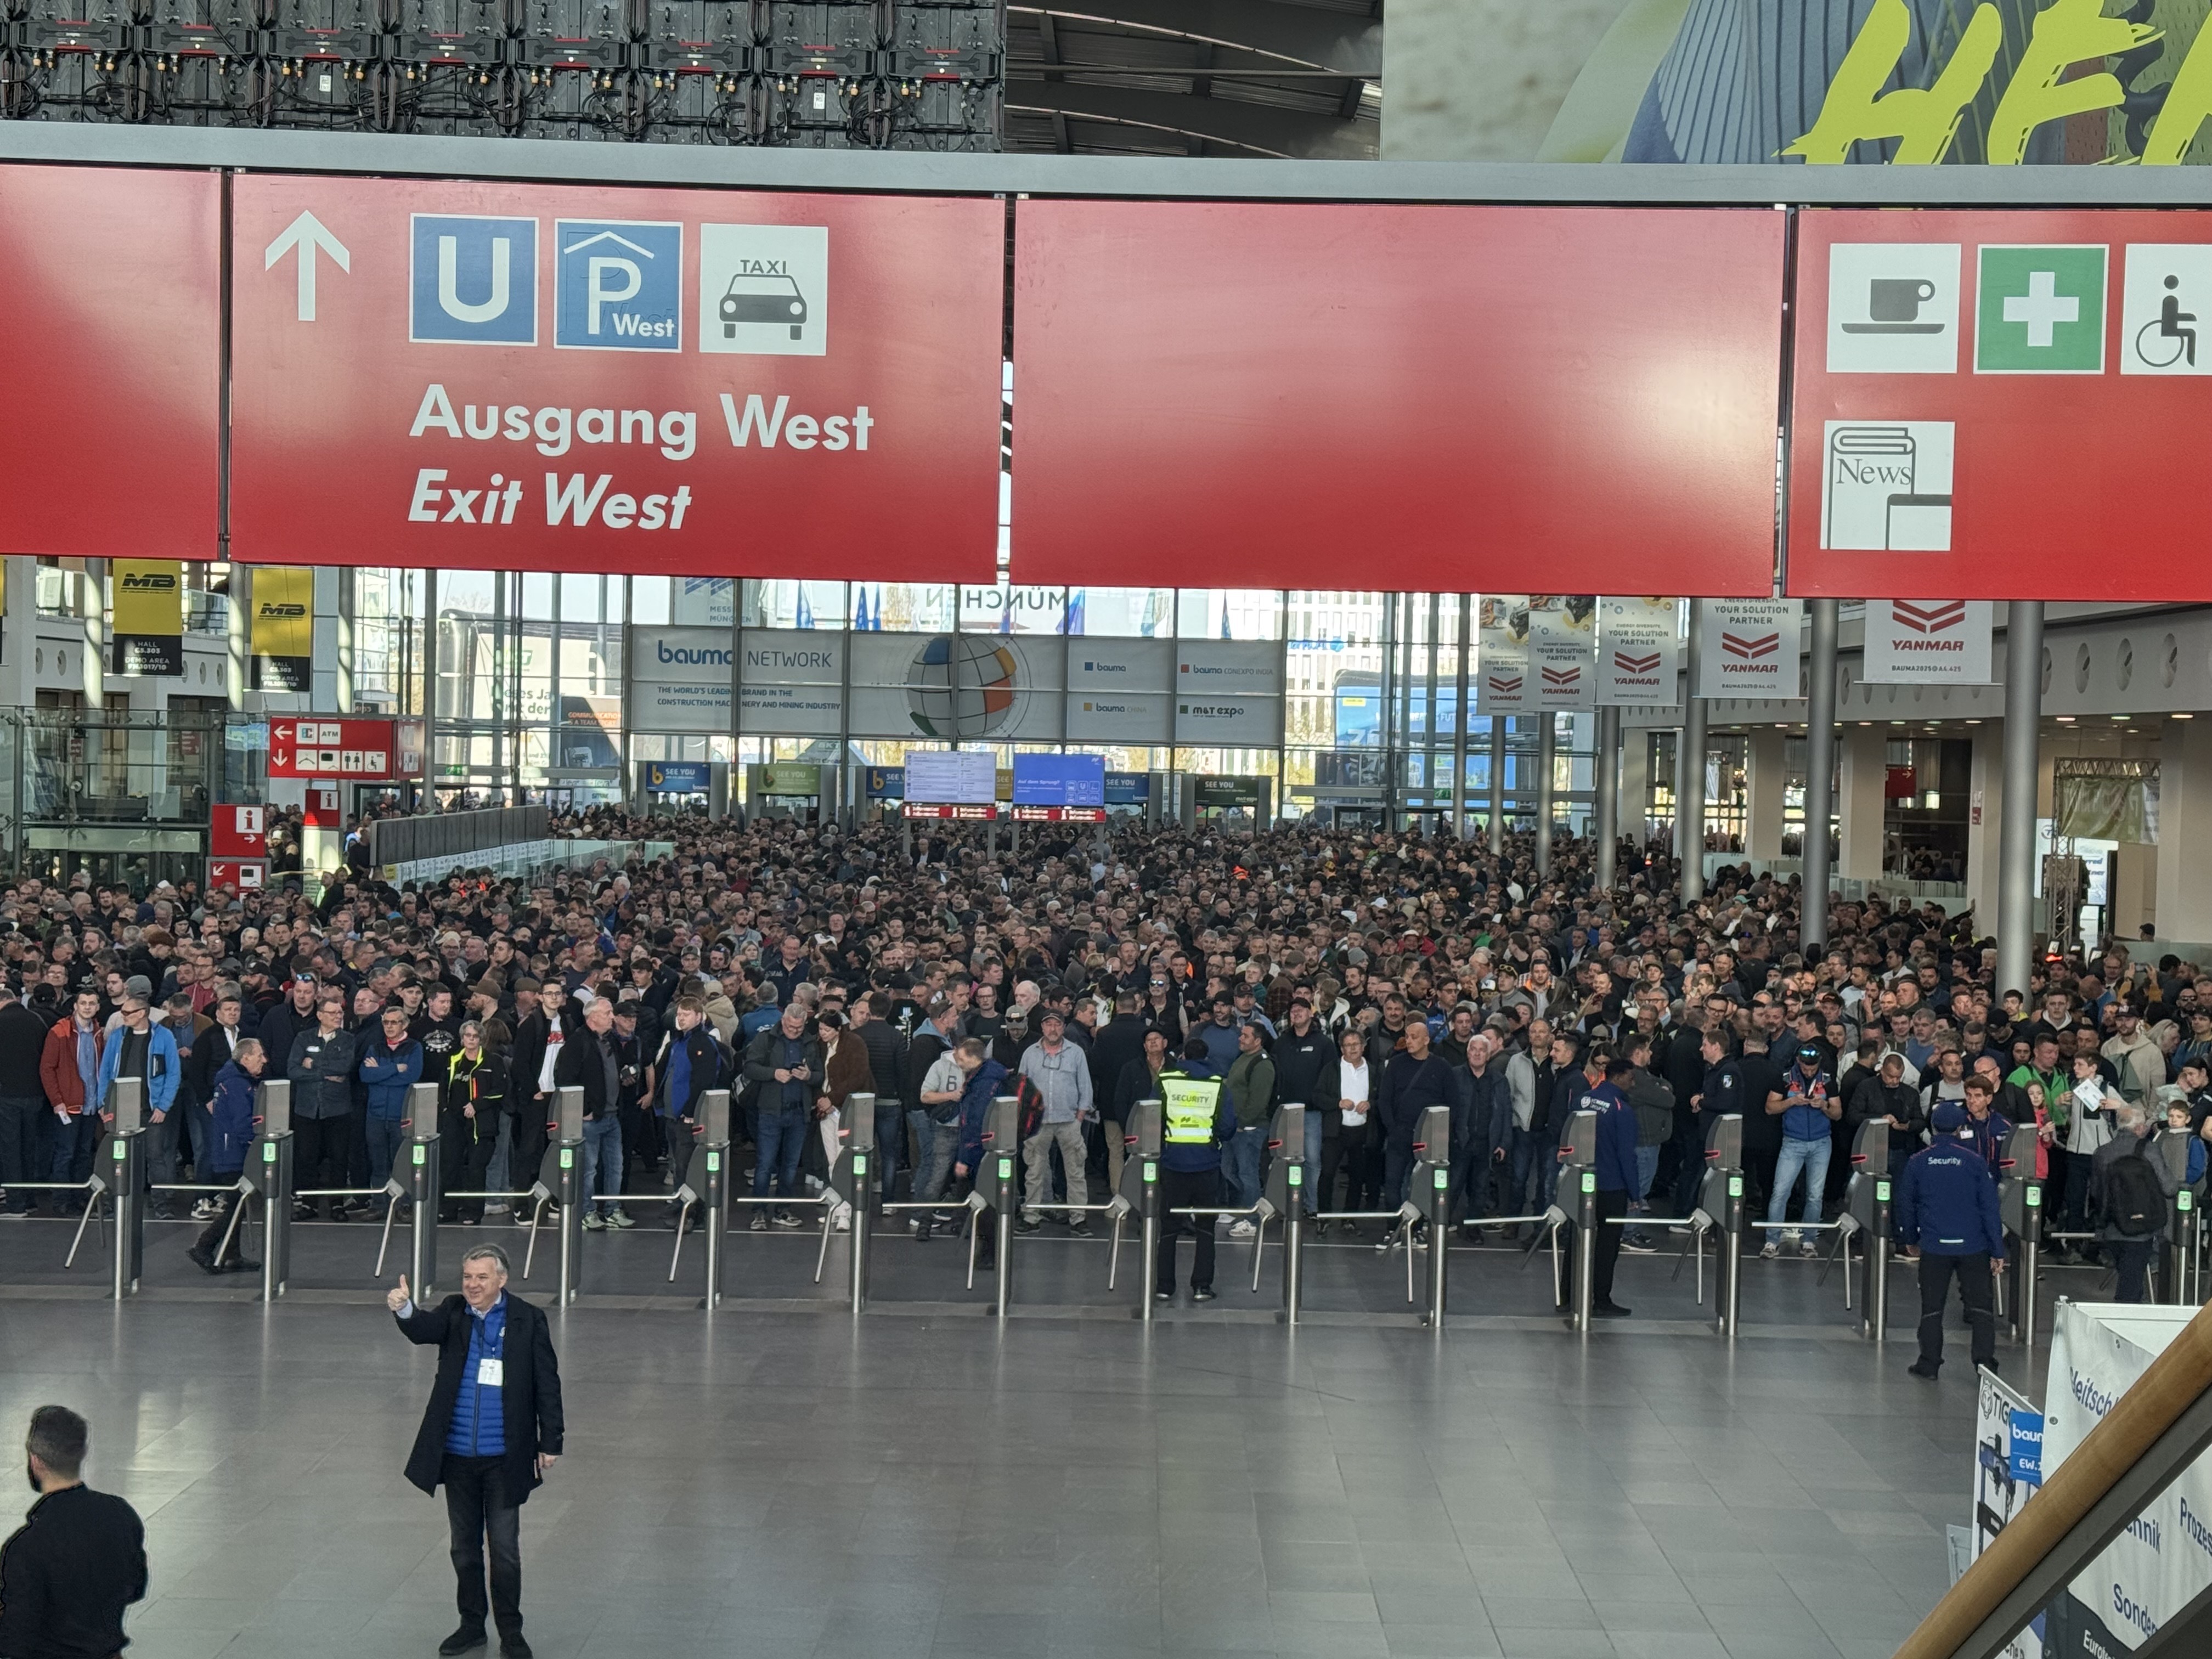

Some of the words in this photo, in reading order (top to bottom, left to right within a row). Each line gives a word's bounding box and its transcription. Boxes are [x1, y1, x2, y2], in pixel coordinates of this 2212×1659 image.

[740, 259, 787, 274] TAXI
[612, 313, 675, 337] West
[409, 383, 697, 460] Ausgang
[719, 393, 874, 451] West
[1836, 458, 1911, 486] News
[408, 468, 524, 524] Exit
[545, 472, 692, 529] West
[1892, 640, 1964, 652] YANMAR
[748, 651, 832, 668] NETWORK
[1097, 662, 1126, 672] bauma
[1193, 664, 1222, 674] bauma
[1722, 664, 1778, 673] YANMAR
[1096, 703, 1125, 713] bauma
[1217, 707, 1244, 718] expo
[1172, 1094, 1209, 1103] SECURITY
[1928, 1156, 1961, 1165] Security
